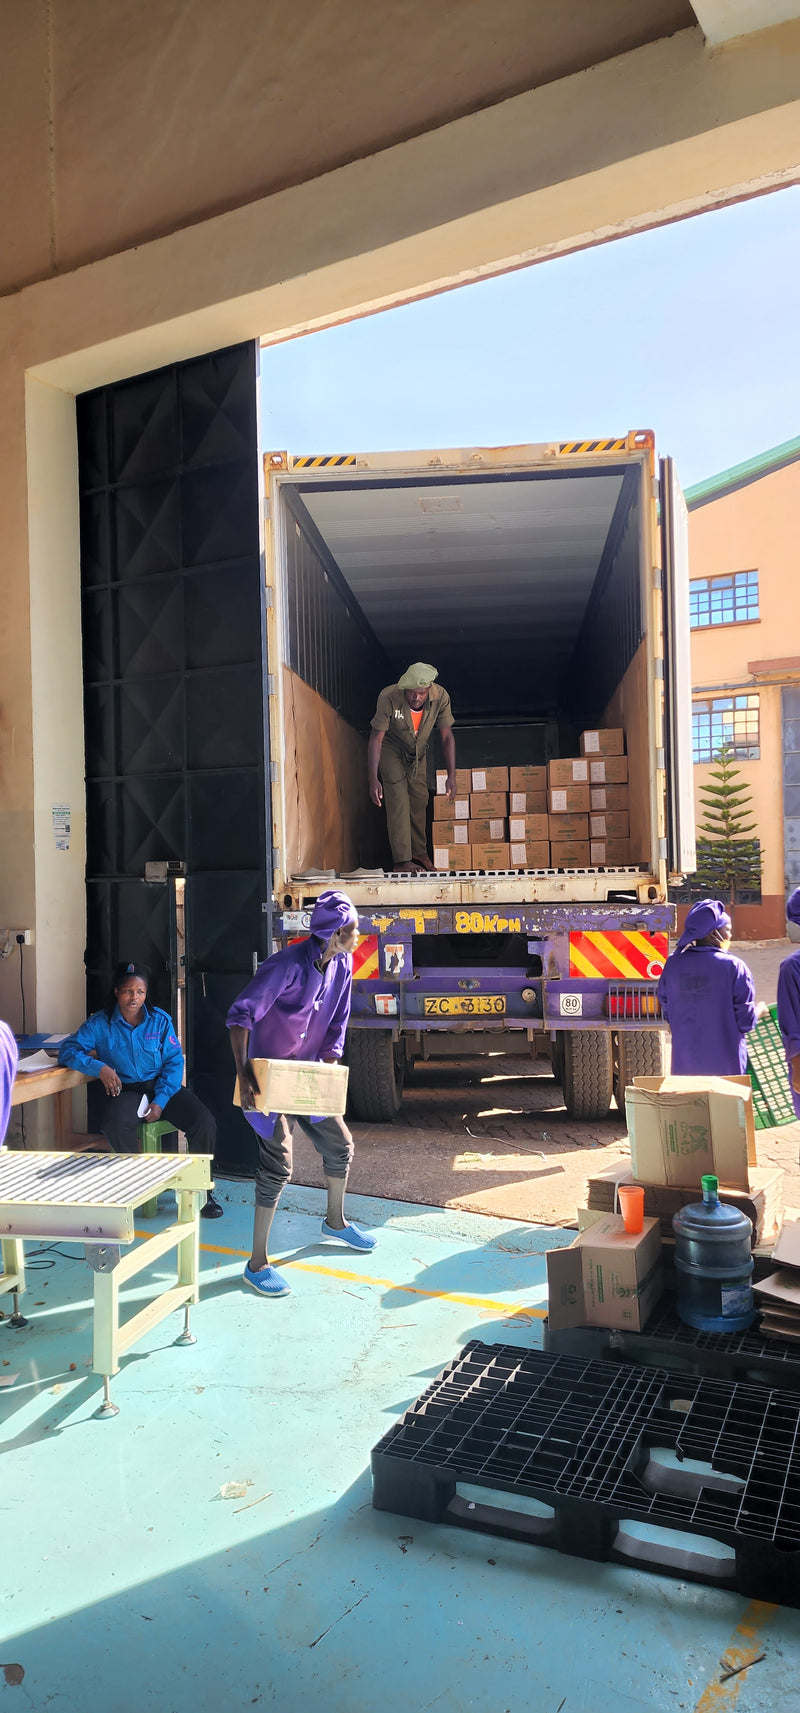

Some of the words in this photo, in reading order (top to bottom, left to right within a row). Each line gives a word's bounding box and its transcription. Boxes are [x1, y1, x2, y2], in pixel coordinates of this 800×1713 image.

[377, 996, 394, 1014] T
[426, 999, 450, 1014] ZC
[565, 998, 578, 1008] 80
